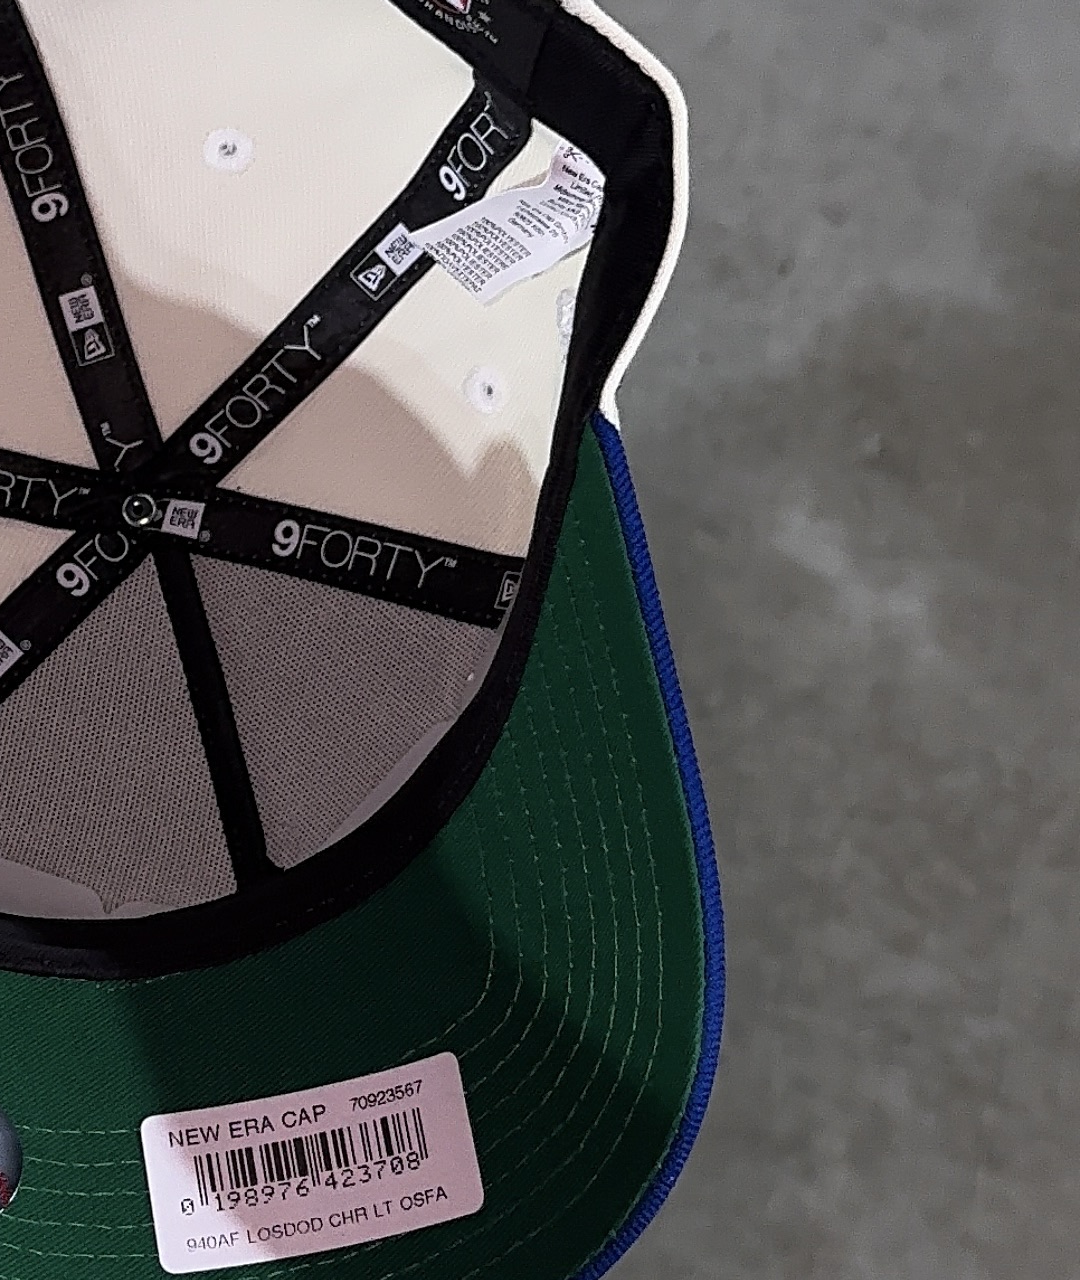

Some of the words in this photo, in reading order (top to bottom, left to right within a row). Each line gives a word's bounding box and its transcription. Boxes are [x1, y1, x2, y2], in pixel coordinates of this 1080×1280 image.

[439, 92, 509, 201] 9FOR
[170, 516, 195, 529] ERA
[172, 506, 197, 519] NEW
[56, 531, 129, 597] 9FO
[168, 1124, 220, 1148] NEW
[229, 1117, 275, 1141] ERA
[281, 1104, 326, 1128] CAP
[349, 1079, 423, 1112] 70923567
[180, 1198, 195, 1215] 0
[323, 1151, 421, 1190] 423708
[186, 1232, 240, 1253] 940AF
[246, 1217, 324, 1244] LOSDOD
[328, 1206, 369, 1229] CHR
[373, 1200, 394, 1219] LT
[399, 1185, 448, 1211] OSFA
